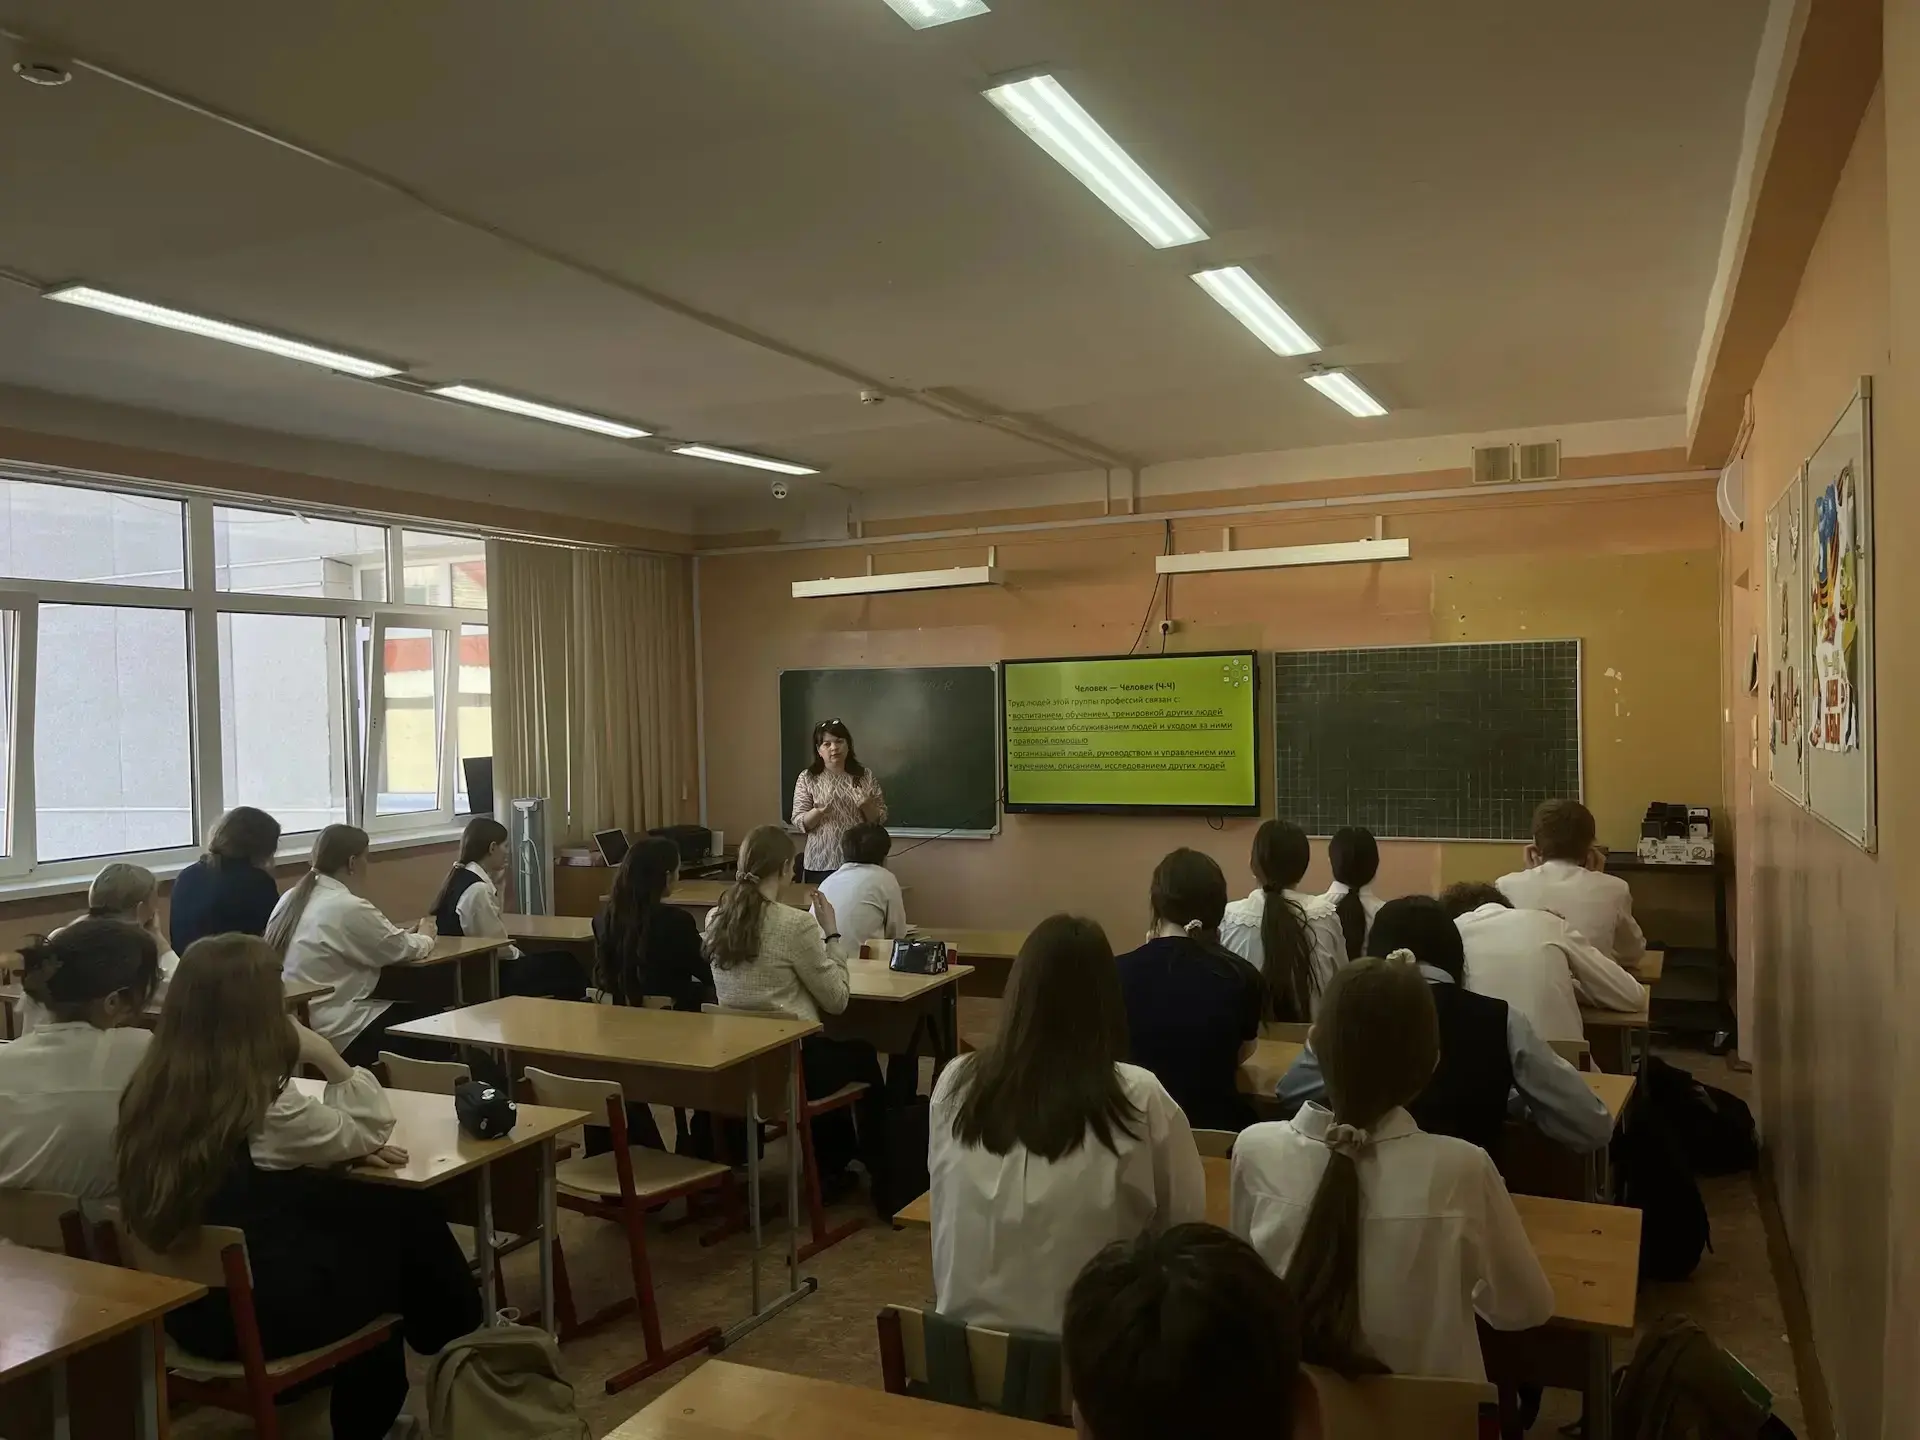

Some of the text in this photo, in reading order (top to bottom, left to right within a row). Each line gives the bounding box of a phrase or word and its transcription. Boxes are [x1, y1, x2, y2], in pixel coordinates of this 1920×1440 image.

[1120, 682, 1154, 692] Человек
[1156, 682, 1176, 692] (Ч-Ч)
[1072, 699, 1099, 708] группы
[1100, 696, 1143, 706] профессий
[1112, 708, 1164, 718] тренировкой
[1166, 709, 1194, 718] других
[1195, 708, 1223, 717] людей
[1012, 724, 1066, 733] медицинским
[1067, 722, 1130, 732] обслуживанием
[1132, 722, 1158, 731] людей
[1013, 750, 1066, 758] организацией
[1068, 750, 1095, 758] людей,
[1096, 749, 1152, 758] руководством
[1162, 748, 1216, 758] управлением
[1104, 762, 1166, 771] исследованием
[1168, 762, 1197, 771] других
[1198, 761, 1226, 770] людей
